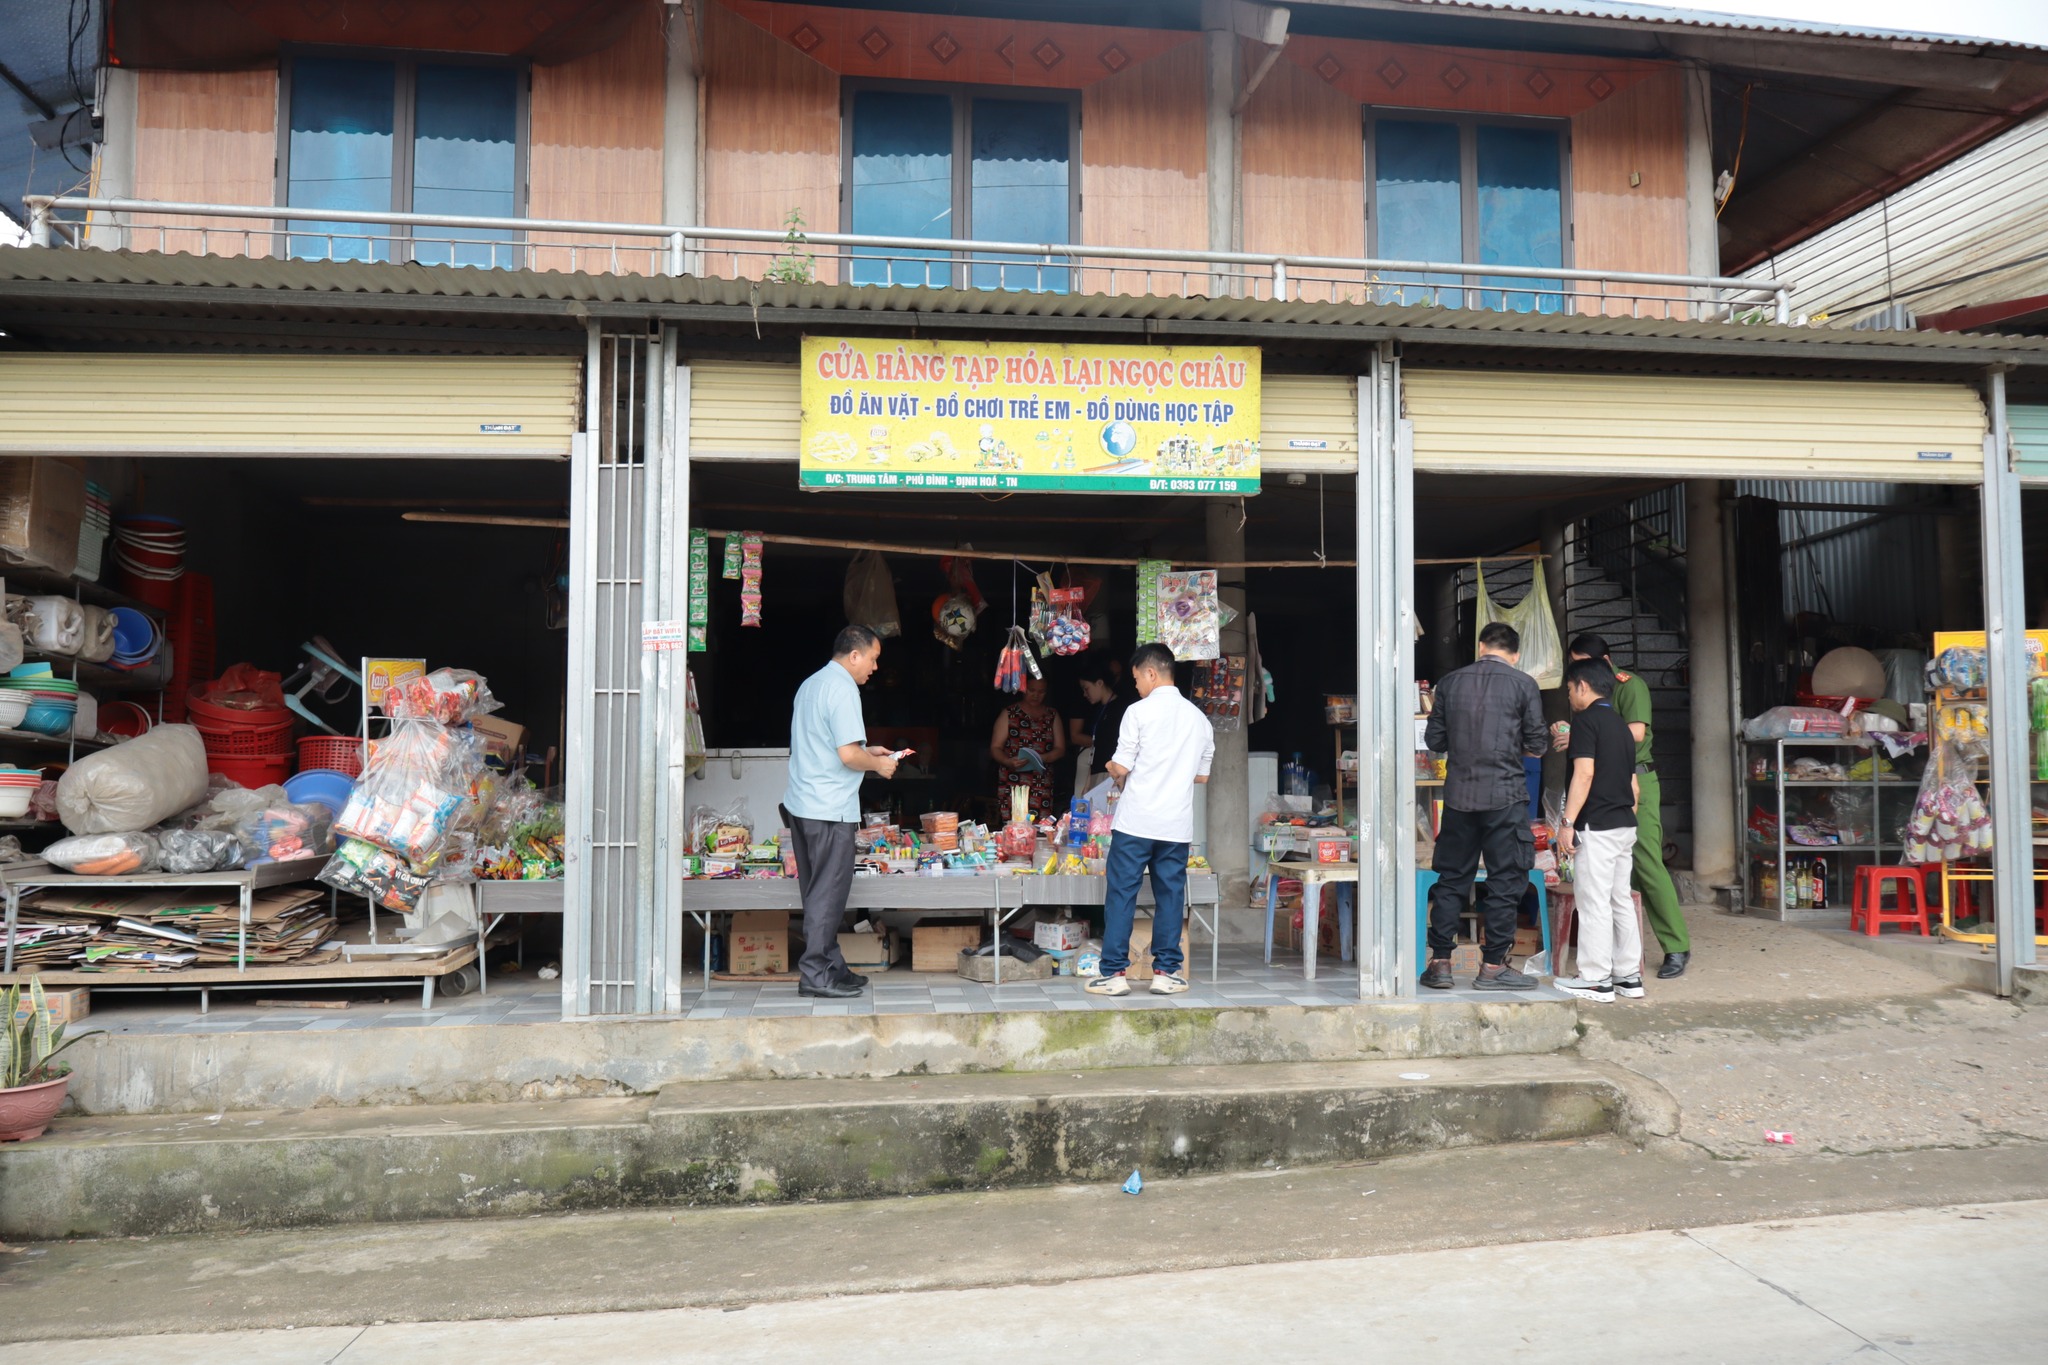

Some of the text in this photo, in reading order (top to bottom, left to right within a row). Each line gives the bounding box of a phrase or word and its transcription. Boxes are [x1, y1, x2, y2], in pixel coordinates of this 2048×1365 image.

[818, 341, 1246, 394] CỬA HÀNG TẠP HÓA LẠI NGỌC CHÂU
[830, 389, 853, 415] ĐỒ
[858, 391, 883, 416] ĂN
[888, 393, 919, 420] VẶT
[936, 392, 959, 417] ĐỒ
[964, 397, 1004, 419] CHƠI
[1009, 394, 1039, 419] TRẺ
[1045, 400, 1070, 420] EM
[1087, 395, 1110, 421] ĐỒ
[1115, 398, 1160, 422] DÙNG
[1165, 402, 1198, 426] HỌC
[1203, 399, 1234, 427] TẬP
[825, 473, 844, 484] Đ/C:
[846, 474, 876, 485] TRUNG
[878, 473, 898, 485] TÂM
[905, 474, 924, 485] PHÚ
[926, 475, 948, 486] ĐÌNH
[955, 476, 977, 488] ĐỊNH
[979, 475, 998, 487] HOÁ
[1006, 477, 1018, 487] TN
[1149, 479, 1237, 491] Đ/T: 0383 077 159
